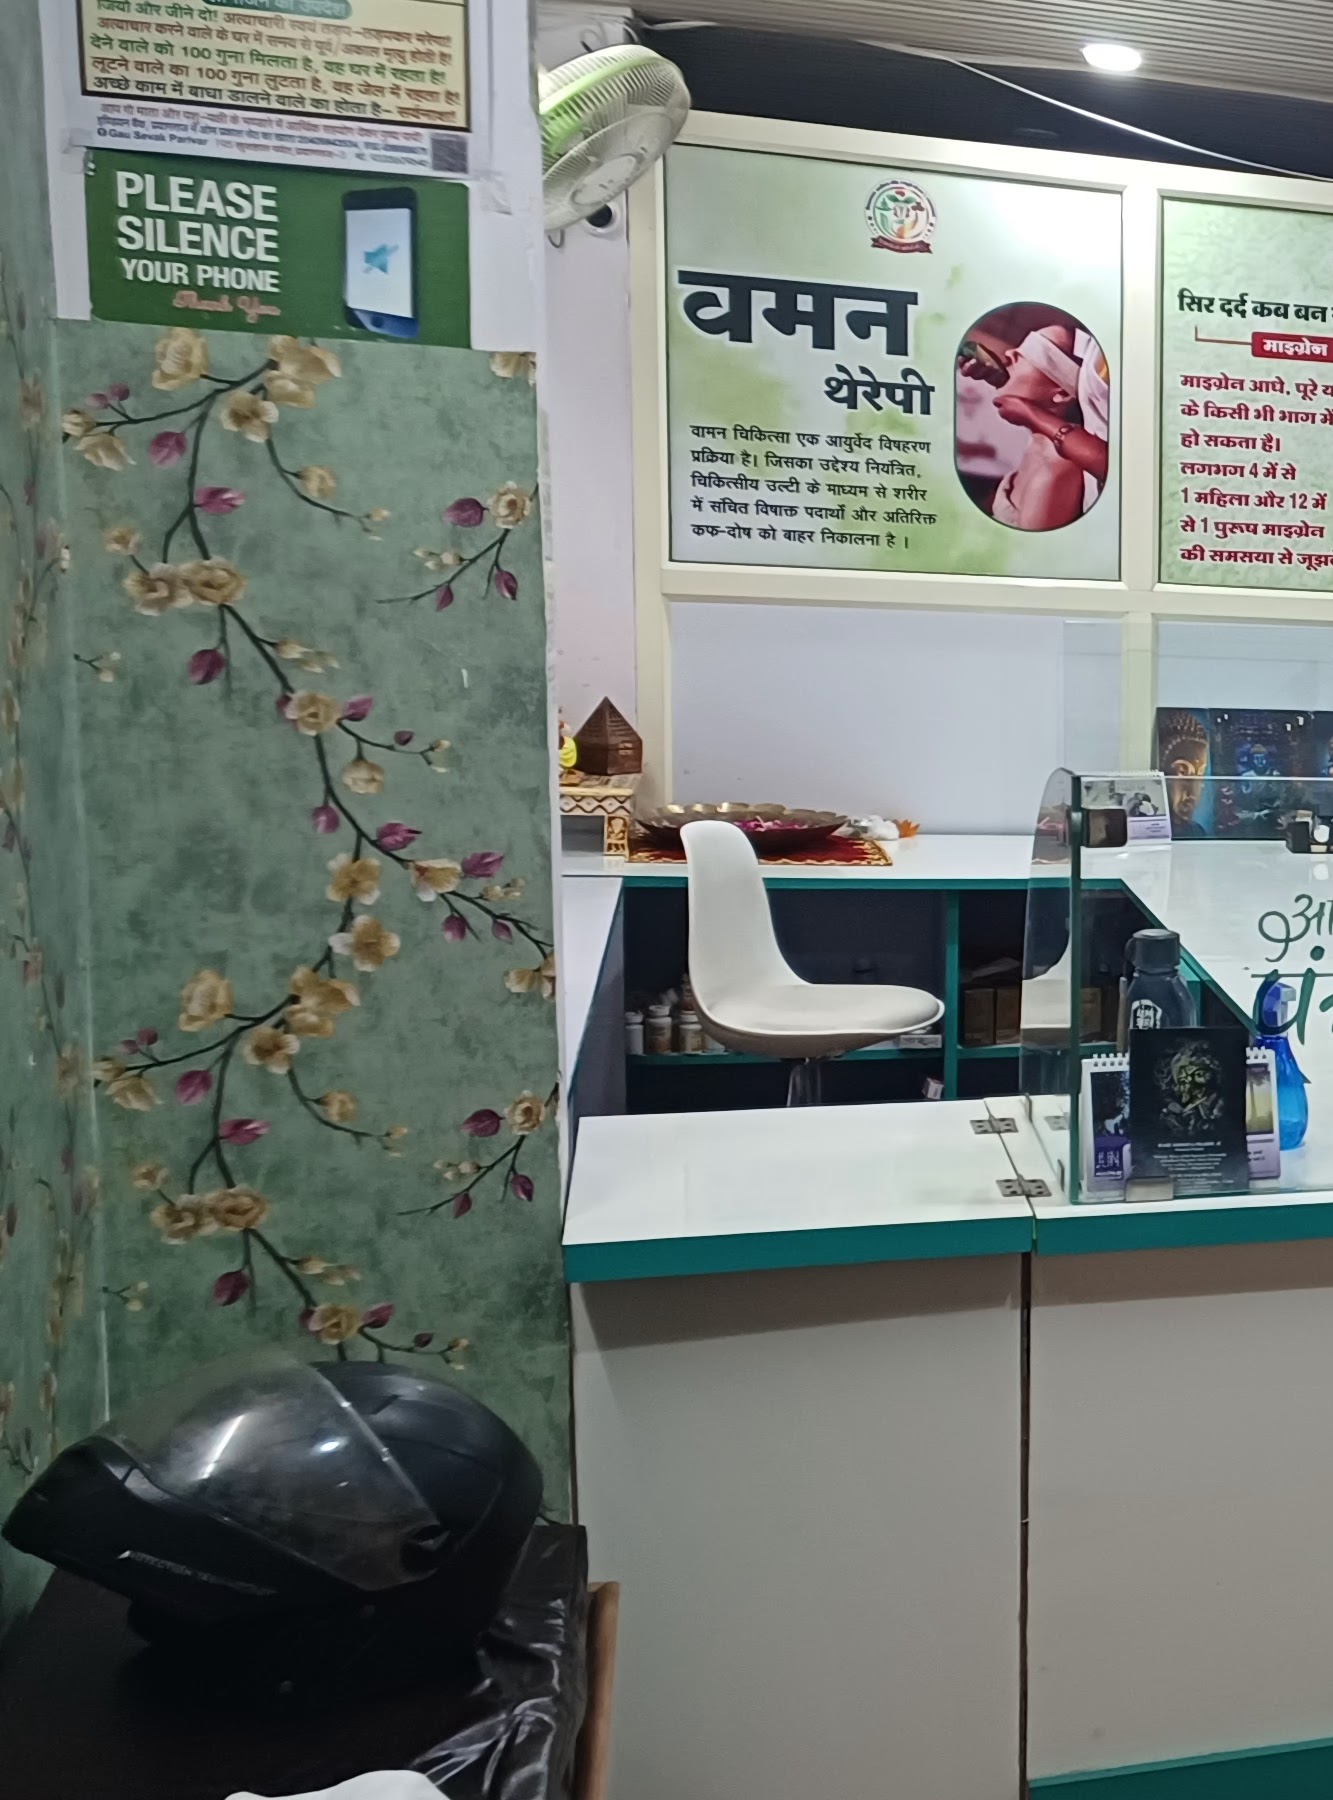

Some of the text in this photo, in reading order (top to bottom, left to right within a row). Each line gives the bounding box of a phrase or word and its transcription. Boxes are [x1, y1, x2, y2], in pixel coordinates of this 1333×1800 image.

[90, 33, 114, 49] देने
[118, 37, 149, 53] वाले
[153, 40, 174, 56] को
[181, 46, 211, 59] 100
[216, 50, 245, 66] गुना
[250, 49, 297, 69] मिलता
[91, 55, 129, 74] लूटने
[134, 59, 164, 75] वाले
[169, 63, 189, 77] का
[197, 67, 227, 81] 100
[231, 70, 260, 87] गुना
[116, 171, 279, 223] PLEASE
[116, 215, 280, 263] SILENCE
[121, 257, 280, 293] YOUR PHONE
[678, 269, 919, 357] वमन
[1178, 288, 1214, 314] सिर
[1219, 293, 1248, 319] दर्द
[1252, 301, 1288, 320] कब
[1294, 303, 1327, 322] बन
[1262, 338, 1328, 357] माइग्रेन
[824, 364, 935, 415] थेरेपी
[1180, 372, 1244, 393] माइग्रेन
[1295, 378, 1318, 401] पूरे
[691, 424, 931, 454] वामन चिकित्सा एक आयुर्वेद विषहरण
[691, 446, 859, 473] प्रक्रिया है। जिसका उद्देश्य
[1180, 462, 1296, 480] लगभग 4 में से
[1180, 544, 1204, 562] की
[1278, 547, 1292, 565] से
